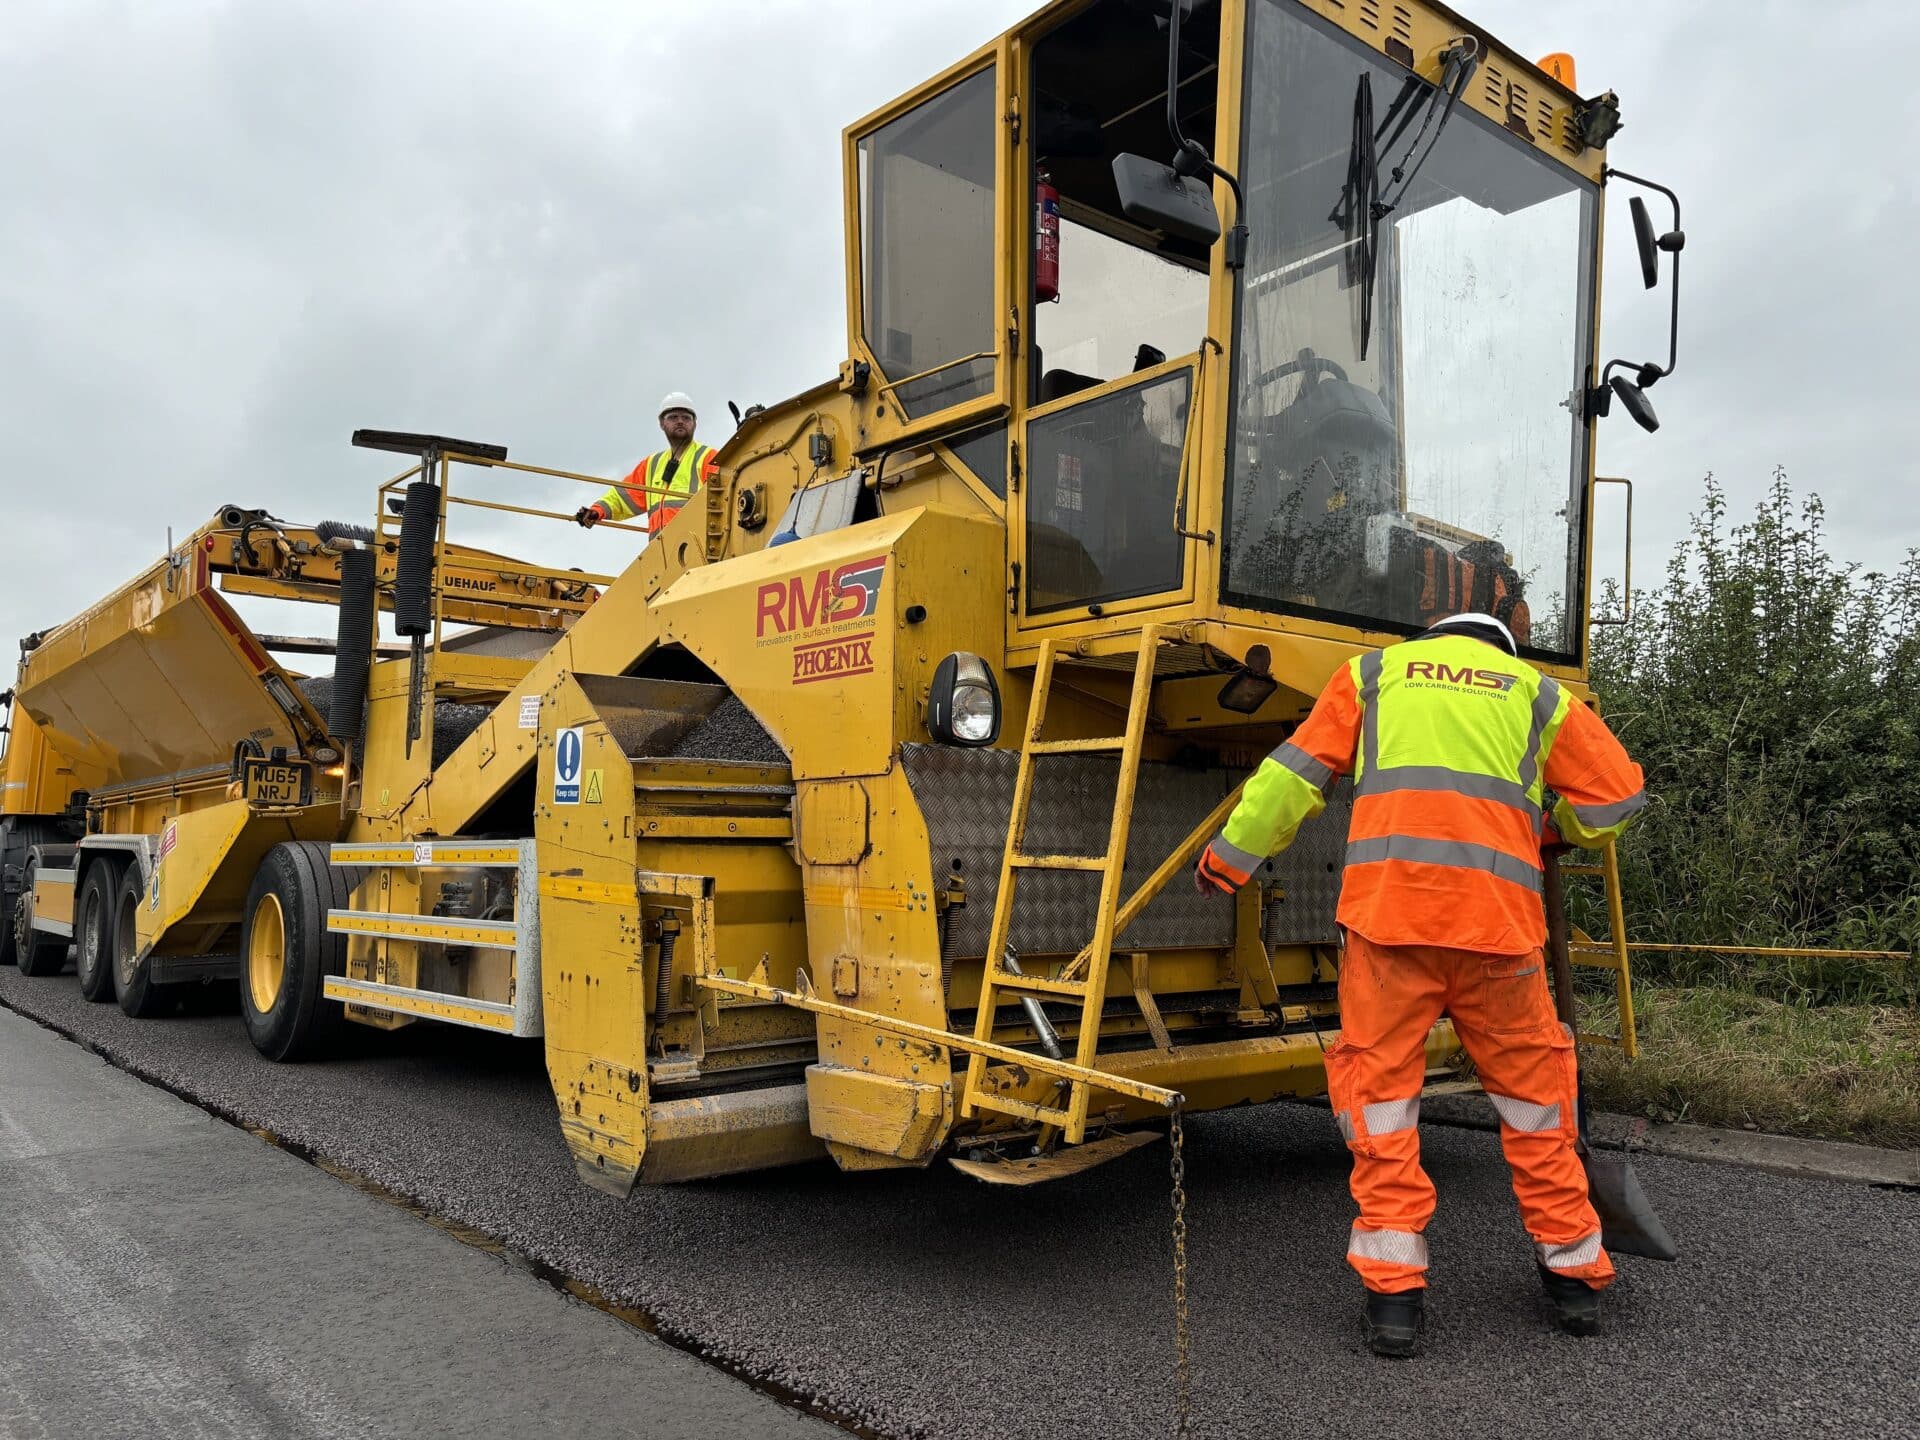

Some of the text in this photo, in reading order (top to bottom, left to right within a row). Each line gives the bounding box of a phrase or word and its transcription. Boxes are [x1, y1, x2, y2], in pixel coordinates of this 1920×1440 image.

[431, 571, 497, 592] UEHAUF
[756, 555, 888, 637] RMS
[756, 618, 876, 648] Innovators in surface treatments
[793, 641, 873, 677] PHOENIX
[1406, 661, 1518, 692] RMS
[1425, 682, 1460, 693] CARBON
[1462, 687, 1508, 701] SOLUTIONS
[253, 767, 297, 784] WU65
[258, 785, 291, 800] NRJ
